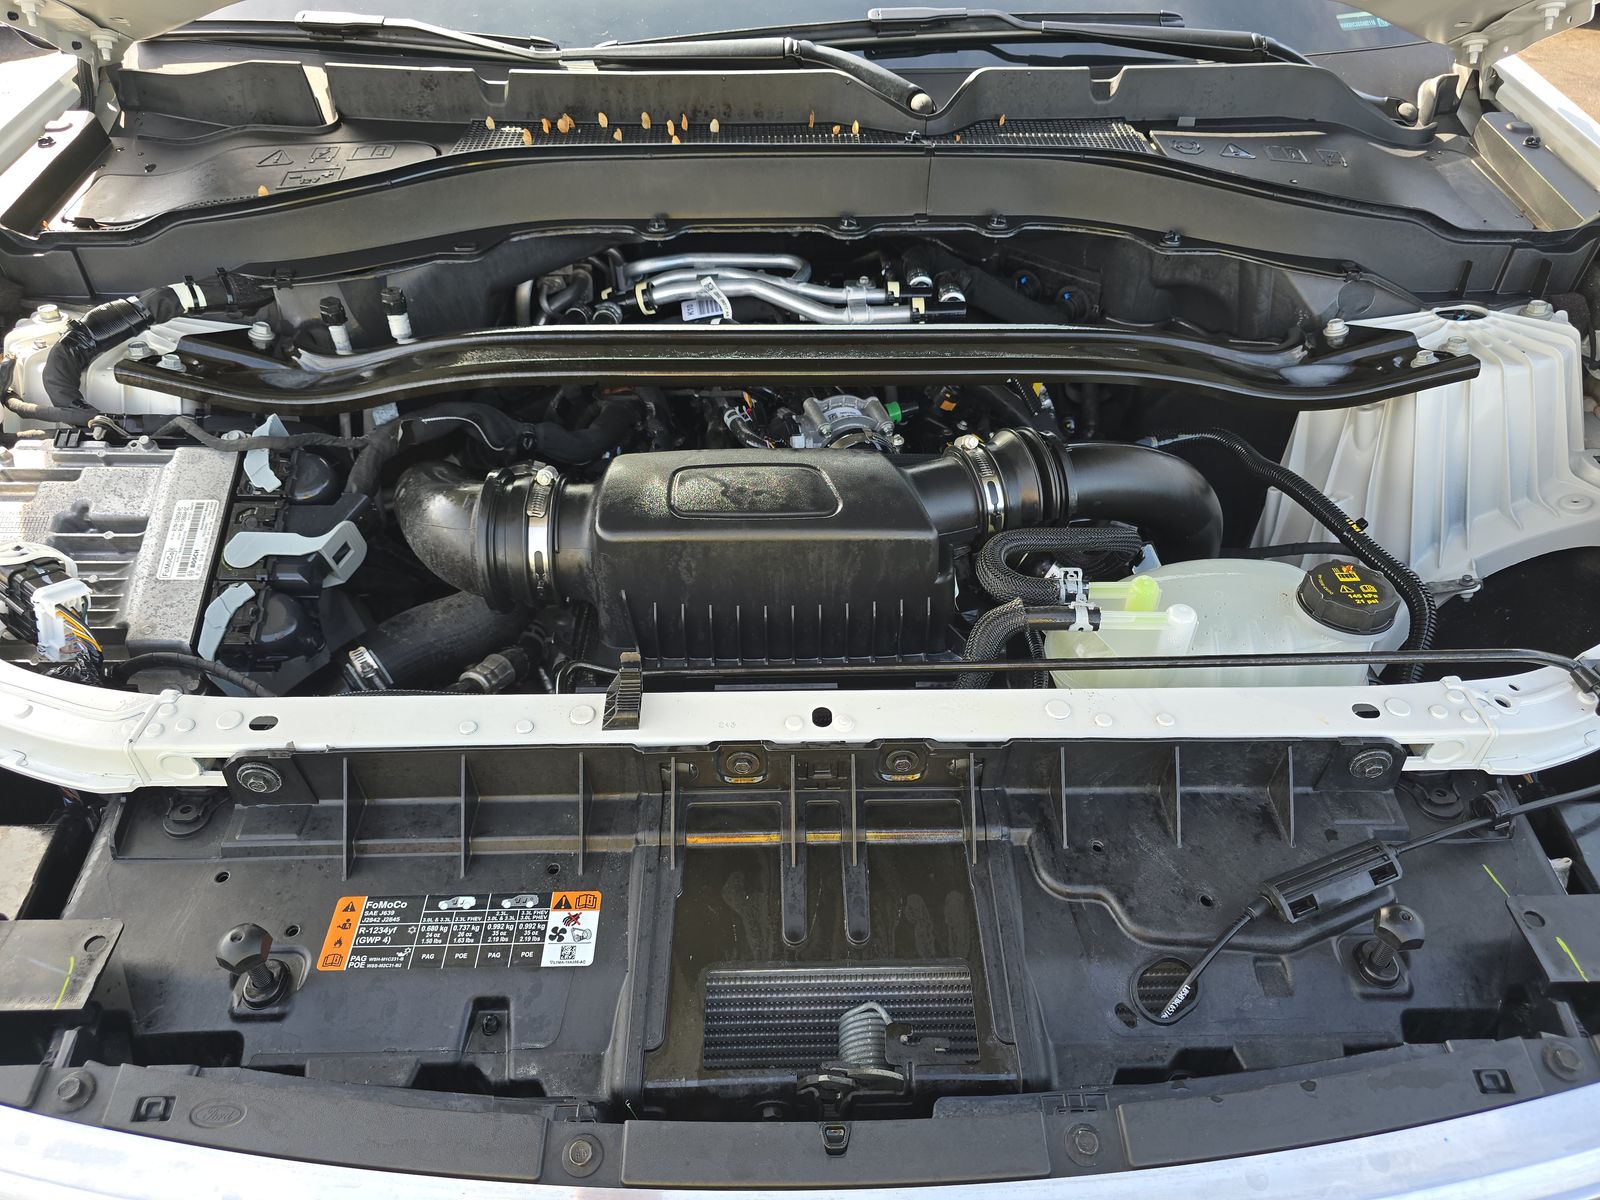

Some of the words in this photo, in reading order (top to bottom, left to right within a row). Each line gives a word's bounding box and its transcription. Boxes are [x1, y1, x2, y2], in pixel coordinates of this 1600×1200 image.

[191, 549, 199, 568] BOSCH
[162, 551, 174, 577] FoMoCo
[366, 900, 408, 909] FoMoCo
[359, 926, 398, 935] R-1234yf
[355, 936, 381, 945] (GWP
